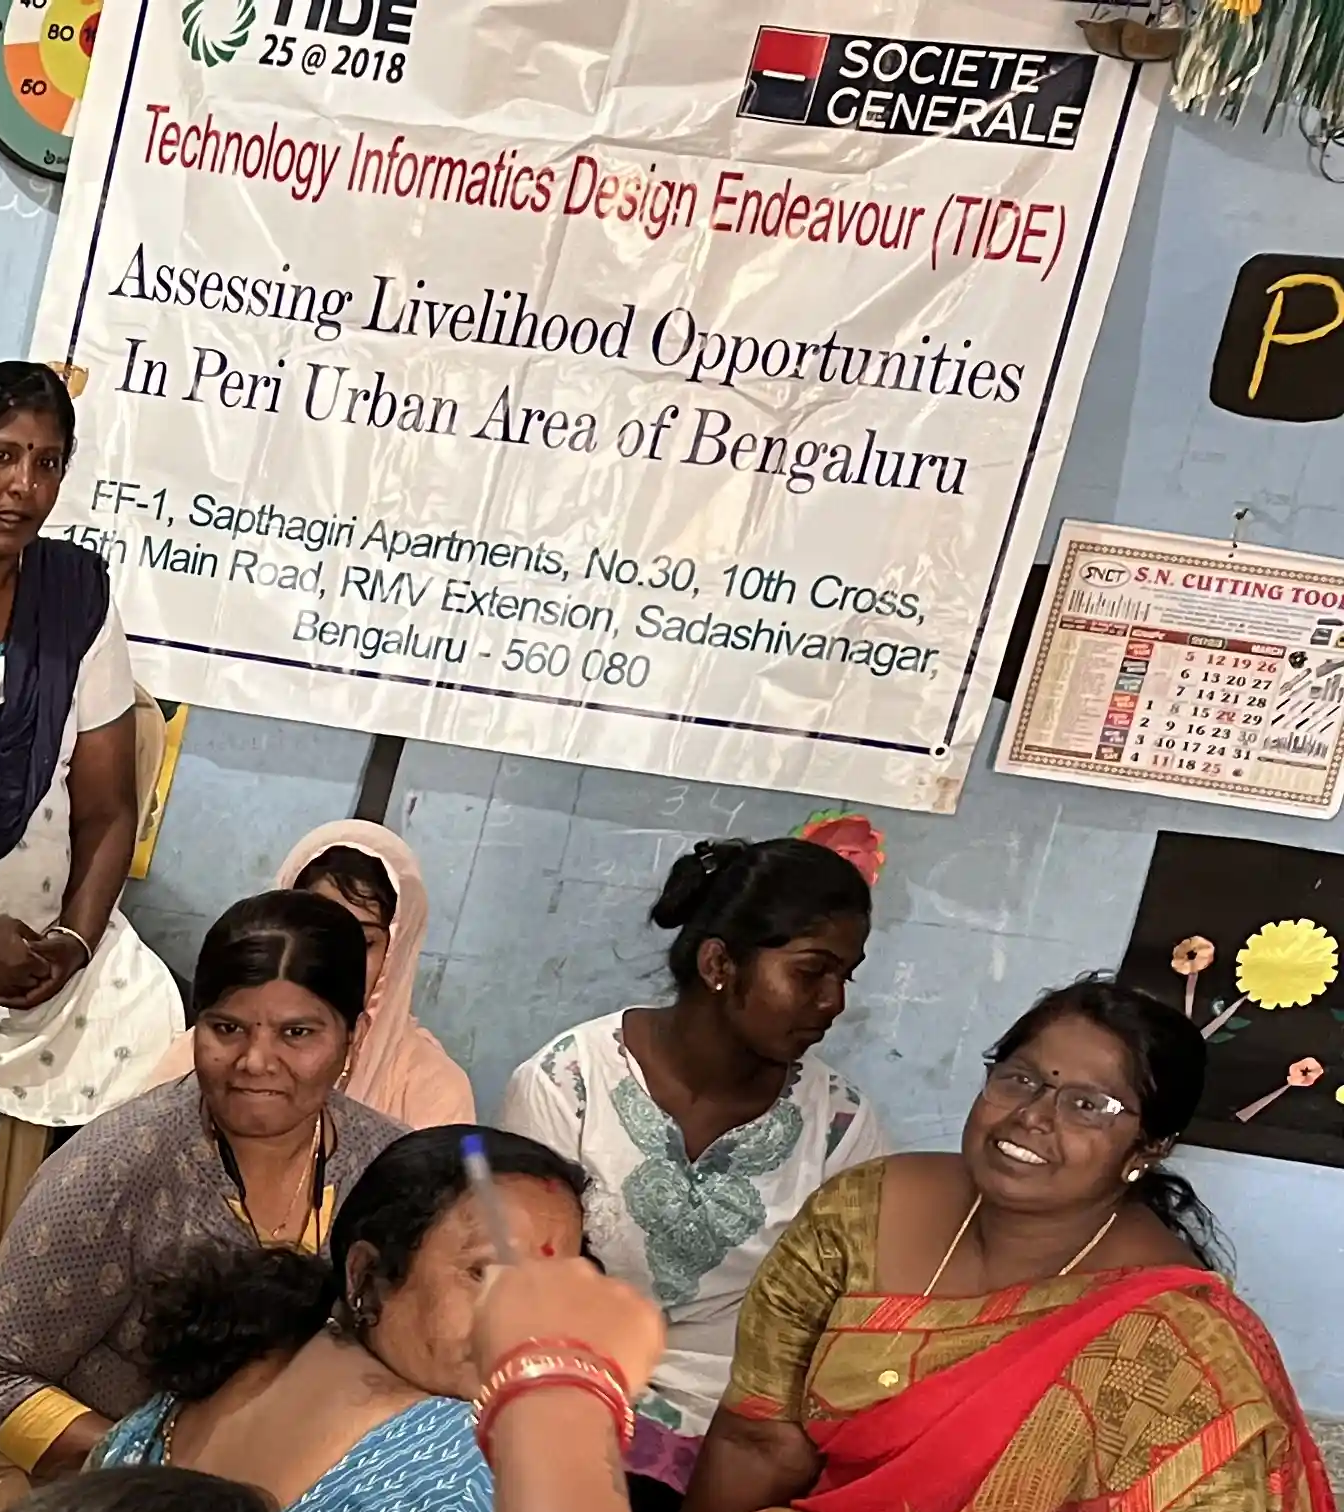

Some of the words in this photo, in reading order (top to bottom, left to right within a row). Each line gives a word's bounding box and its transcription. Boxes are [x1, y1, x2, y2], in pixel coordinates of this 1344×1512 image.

[48, 24, 75, 41] 80
[259, 34, 297, 67] 25
[301, 44, 327, 75] @
[331, 45, 406, 84] 2018
[838, 40, 1048, 92] SOCIETE
[825, 90, 1084, 146] GENERALE
[143, 104, 342, 203] Technology
[347, 132, 556, 213] Informatics
[563, 156, 700, 240] Design
[713, 170, 926, 252] Endeavour
[930, 194, 1067, 281] (TIDE)
[109, 243, 352, 341] Assessing
[364, 276, 635, 360] Livelihood
[652, 307, 1027, 404] Opportunities
[115, 337, 168, 397] In
[182, 346, 286, 413] Peri
[305, 363, 460, 436] Urban
[470, 384, 599, 454] Area
[616, 404, 680, 462] of
[681, 407, 968, 496] Bengaluru
[91, 480, 175, 528] FF-1,
[189, 494, 359, 552] Sapthagiri
[361, 517, 570, 584] Apartments,
[583, 546, 701, 599] No.30,
[722, 563, 797, 606] 10th
[809, 572, 927, 628] Cross,
[138, 535, 219, 578] Main
[229, 549, 326, 600] Road,
[339, 563, 432, 608] RMV
[439, 579, 622, 638] Extension,
[635, 604, 941, 681] Sadashivanagar,
[1134, 567, 1175, 587] S.N.
[1182, 574, 1283, 600] CUTTING
[1292, 588, 1344, 611] TOO
[293, 610, 469, 666] Bengaluru
[502, 638, 571, 679] 560
[581, 649, 651, 688] 080
[1207, 654, 1224, 666] 12
[1232, 657, 1251, 669] 19
[1257, 661, 1277, 673] 26
[1176, 686, 1186, 696] 7
[1197, 689, 1214, 700] 14
[1220, 692, 1239, 703] 21
[1247, 696, 1266, 707] 28
[1181, 669, 1189, 679] 6
[1202, 672, 1220, 683] 13
[1226, 675, 1246, 686] 20
[1252, 679, 1272, 691] 27
[1140, 718, 1149, 727] 2
[1166, 721, 1175, 731] 9
[1187, 724, 1205, 736] 16
[1212, 727, 1231, 739] 23
[1146, 700, 1153, 709] 1
[1192, 707, 1210, 718] 15
[1242, 714, 1262, 725] 29
[1130, 752, 1139, 761] 4
[1177, 758, 1196, 770] 18
[1201, 761, 1221, 774] 25
[1135, 735, 1145, 745] 3
[1183, 741, 1201, 752] 17
[1207, 745, 1225, 756] 24
[1233, 748, 1250, 760] 31
